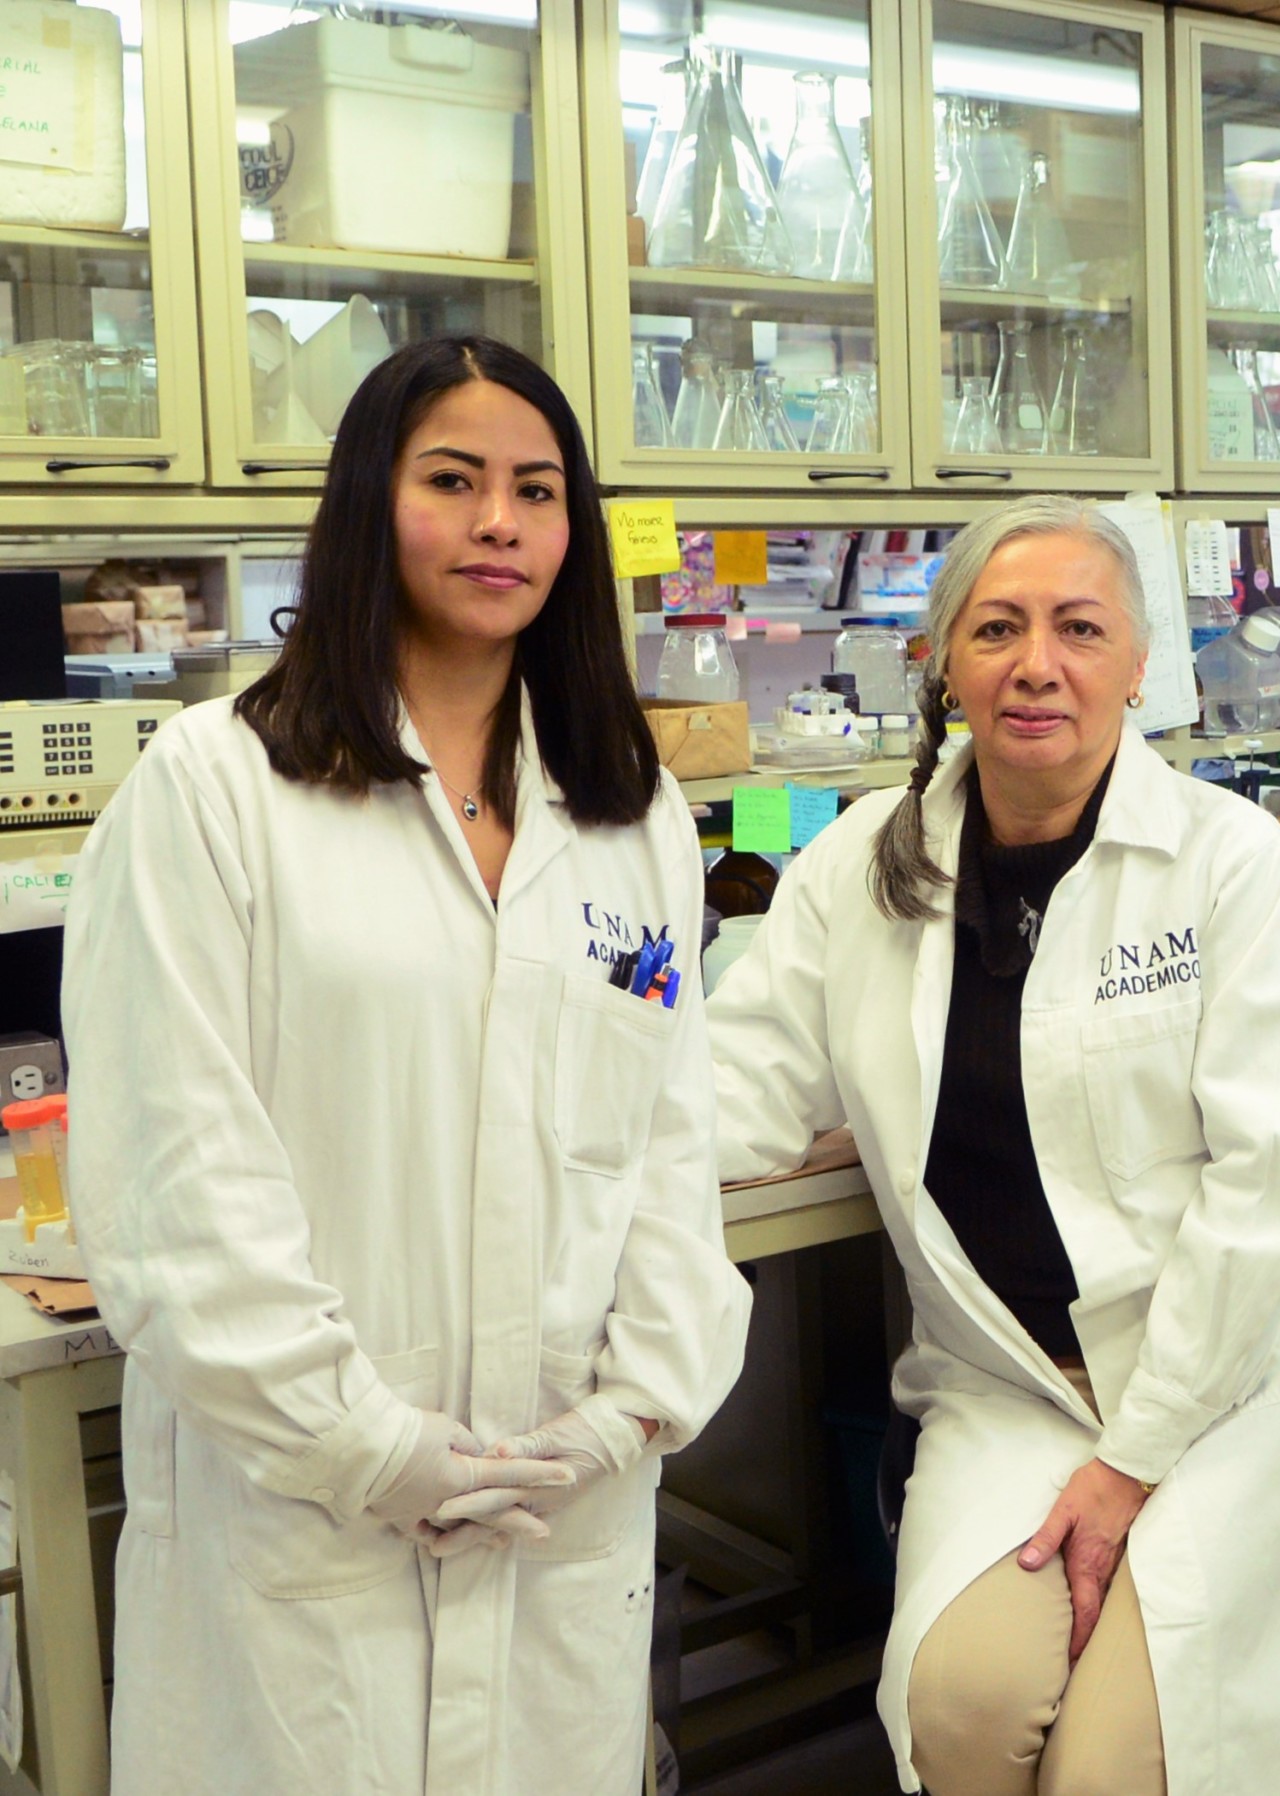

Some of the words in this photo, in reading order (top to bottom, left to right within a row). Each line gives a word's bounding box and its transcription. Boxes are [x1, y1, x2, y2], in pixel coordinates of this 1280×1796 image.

[0, 57, 41, 74] RIAL
[0, 117, 49, 132] ELANA
[581, 902, 670, 952] UNAM
[1100, 927, 1198, 977] UNAM
[1094, 959, 1201, 1006] ACADEMICO
